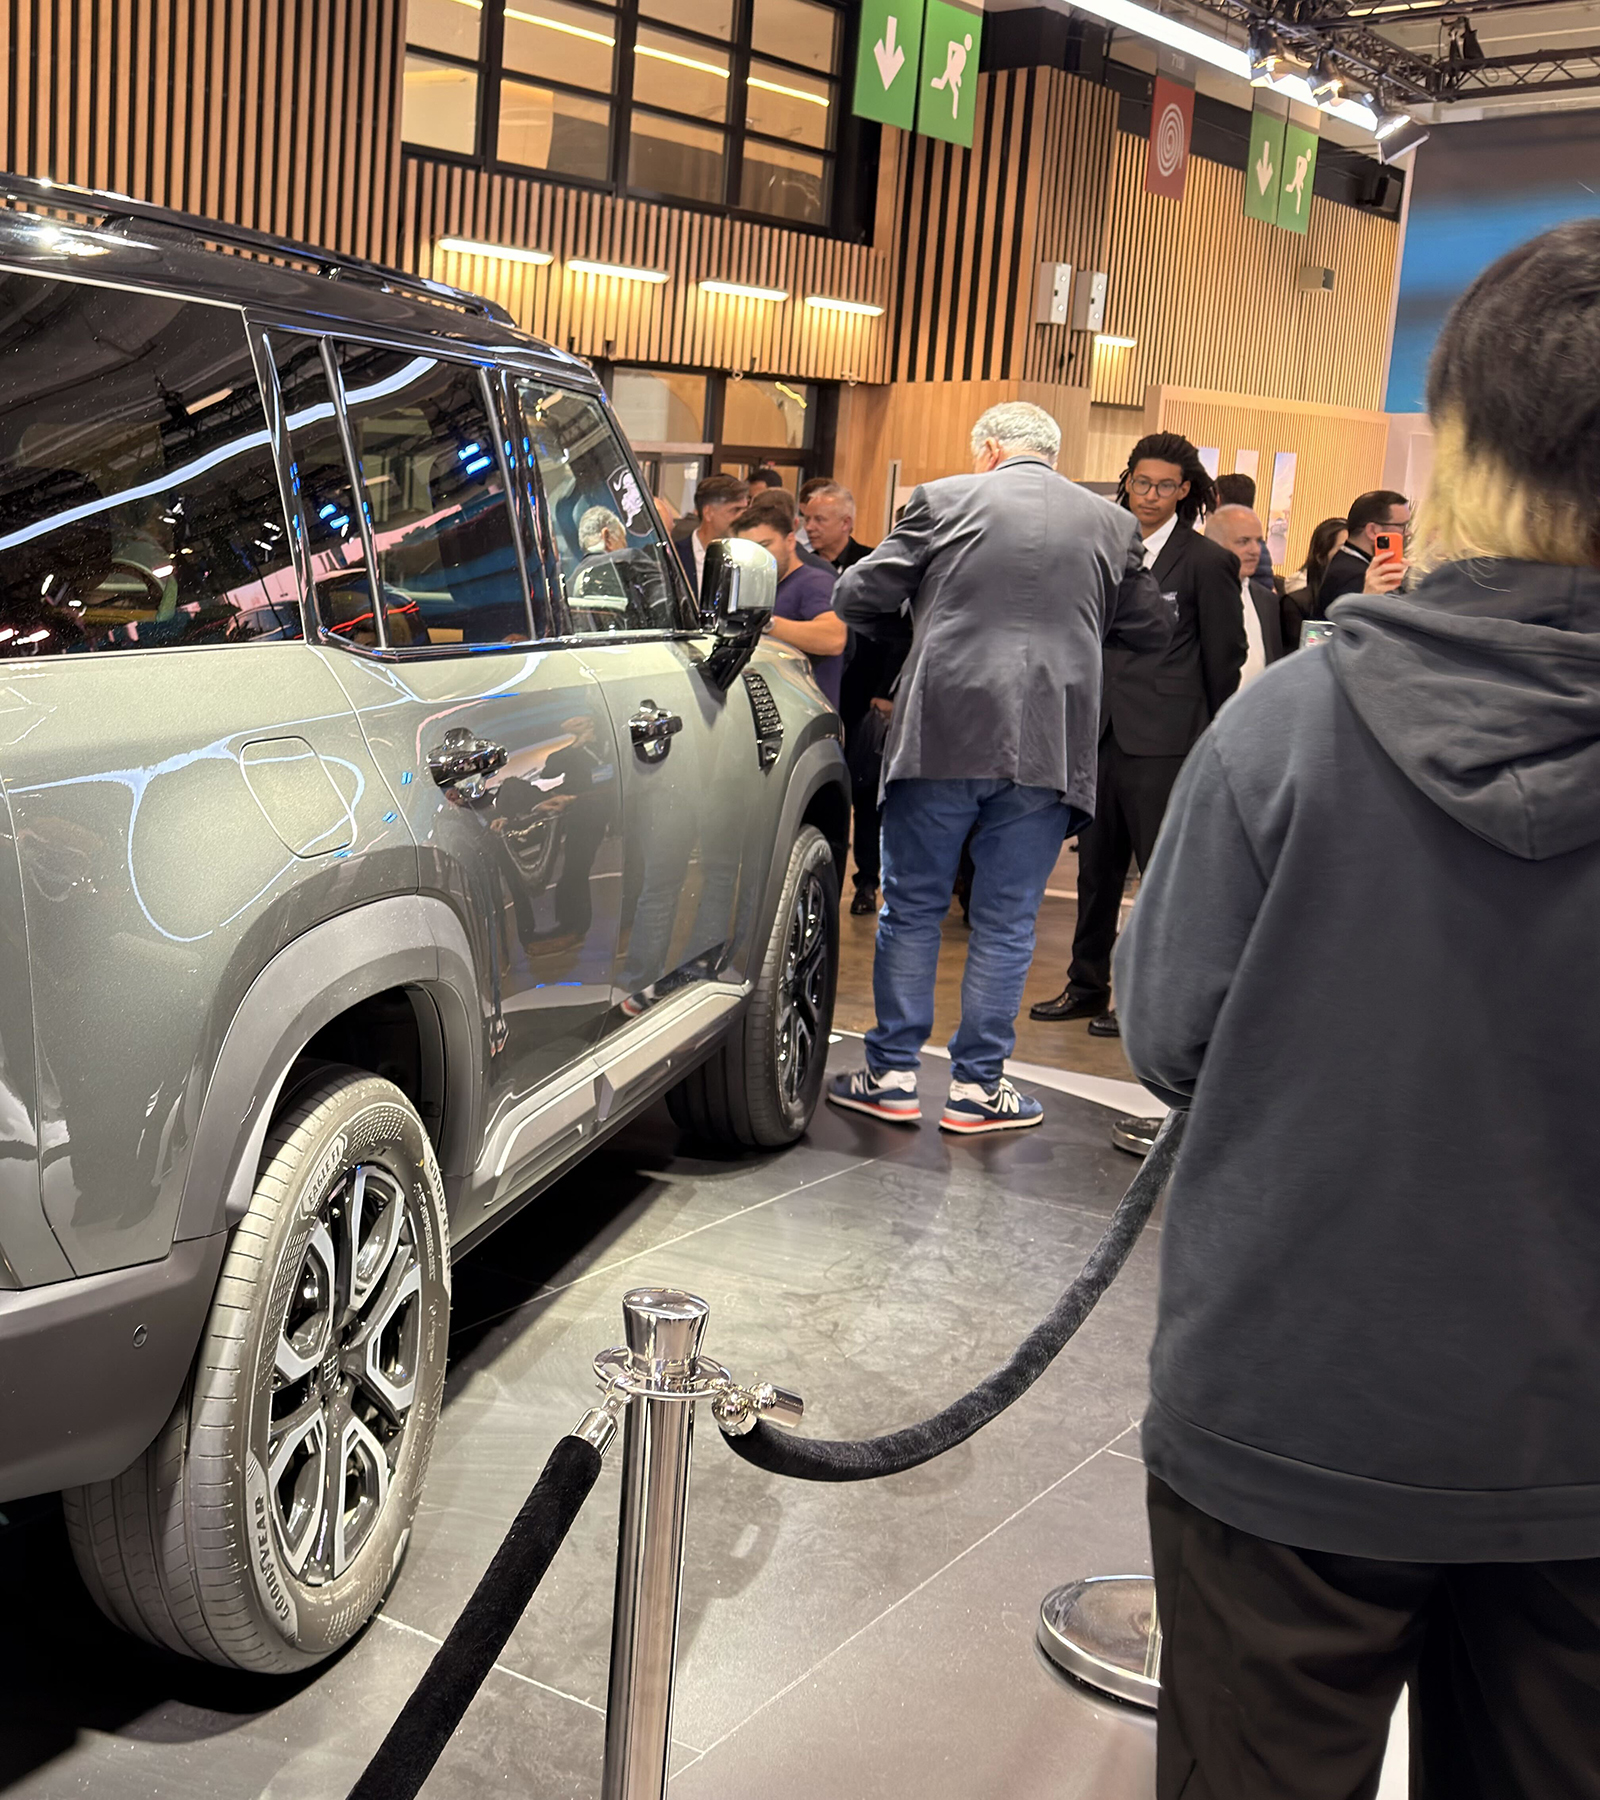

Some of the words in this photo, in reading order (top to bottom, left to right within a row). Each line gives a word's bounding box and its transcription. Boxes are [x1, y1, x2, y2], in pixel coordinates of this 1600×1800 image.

[1002, 1090, 1020, 1114] N
[307, 1159, 331, 1206] EAGLE
[254, 1493, 291, 1622] GOODYEAR
